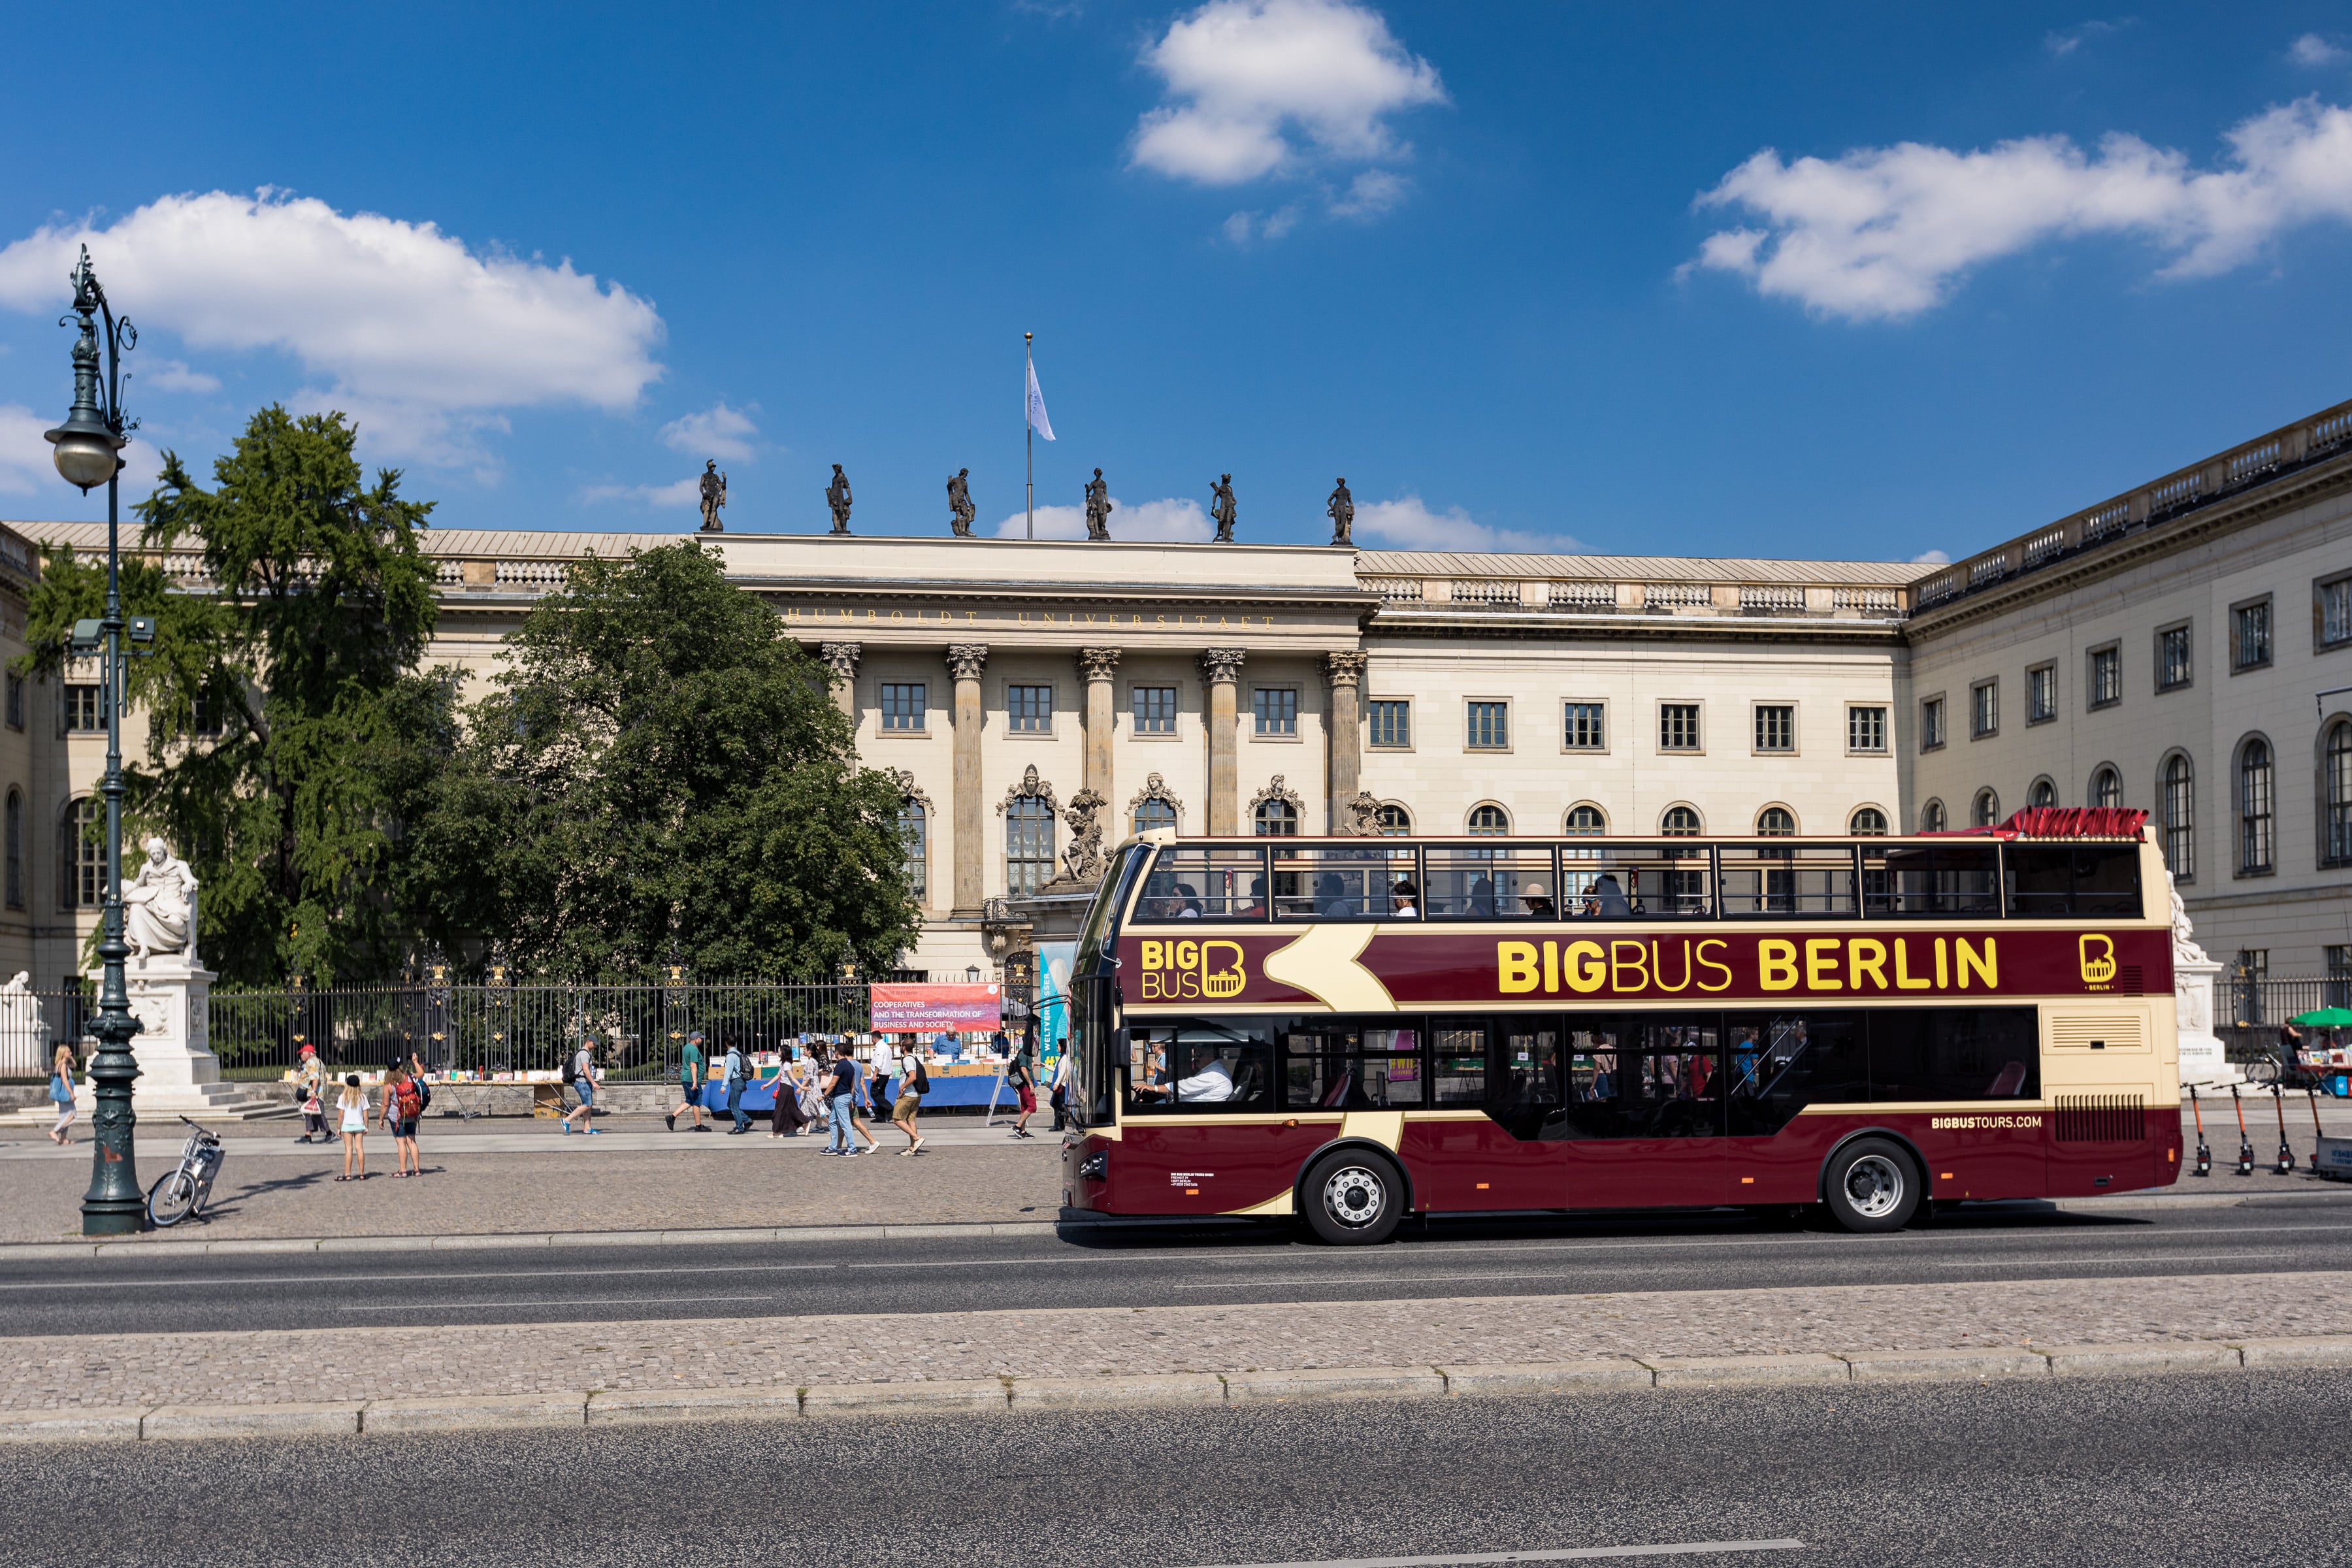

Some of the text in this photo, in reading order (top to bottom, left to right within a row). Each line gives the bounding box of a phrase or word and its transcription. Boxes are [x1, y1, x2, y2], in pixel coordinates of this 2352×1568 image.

[787, 608, 1274, 630] HUMBOLDT UNIVERSITAET
[1141, 940, 1198, 970] BIG
[1497, 937, 1999, 993] BIGBUS BERLIN
[1142, 972, 1200, 999] BUS
[1931, 1116, 2042, 1129] BIGBUSTOURS.COM
